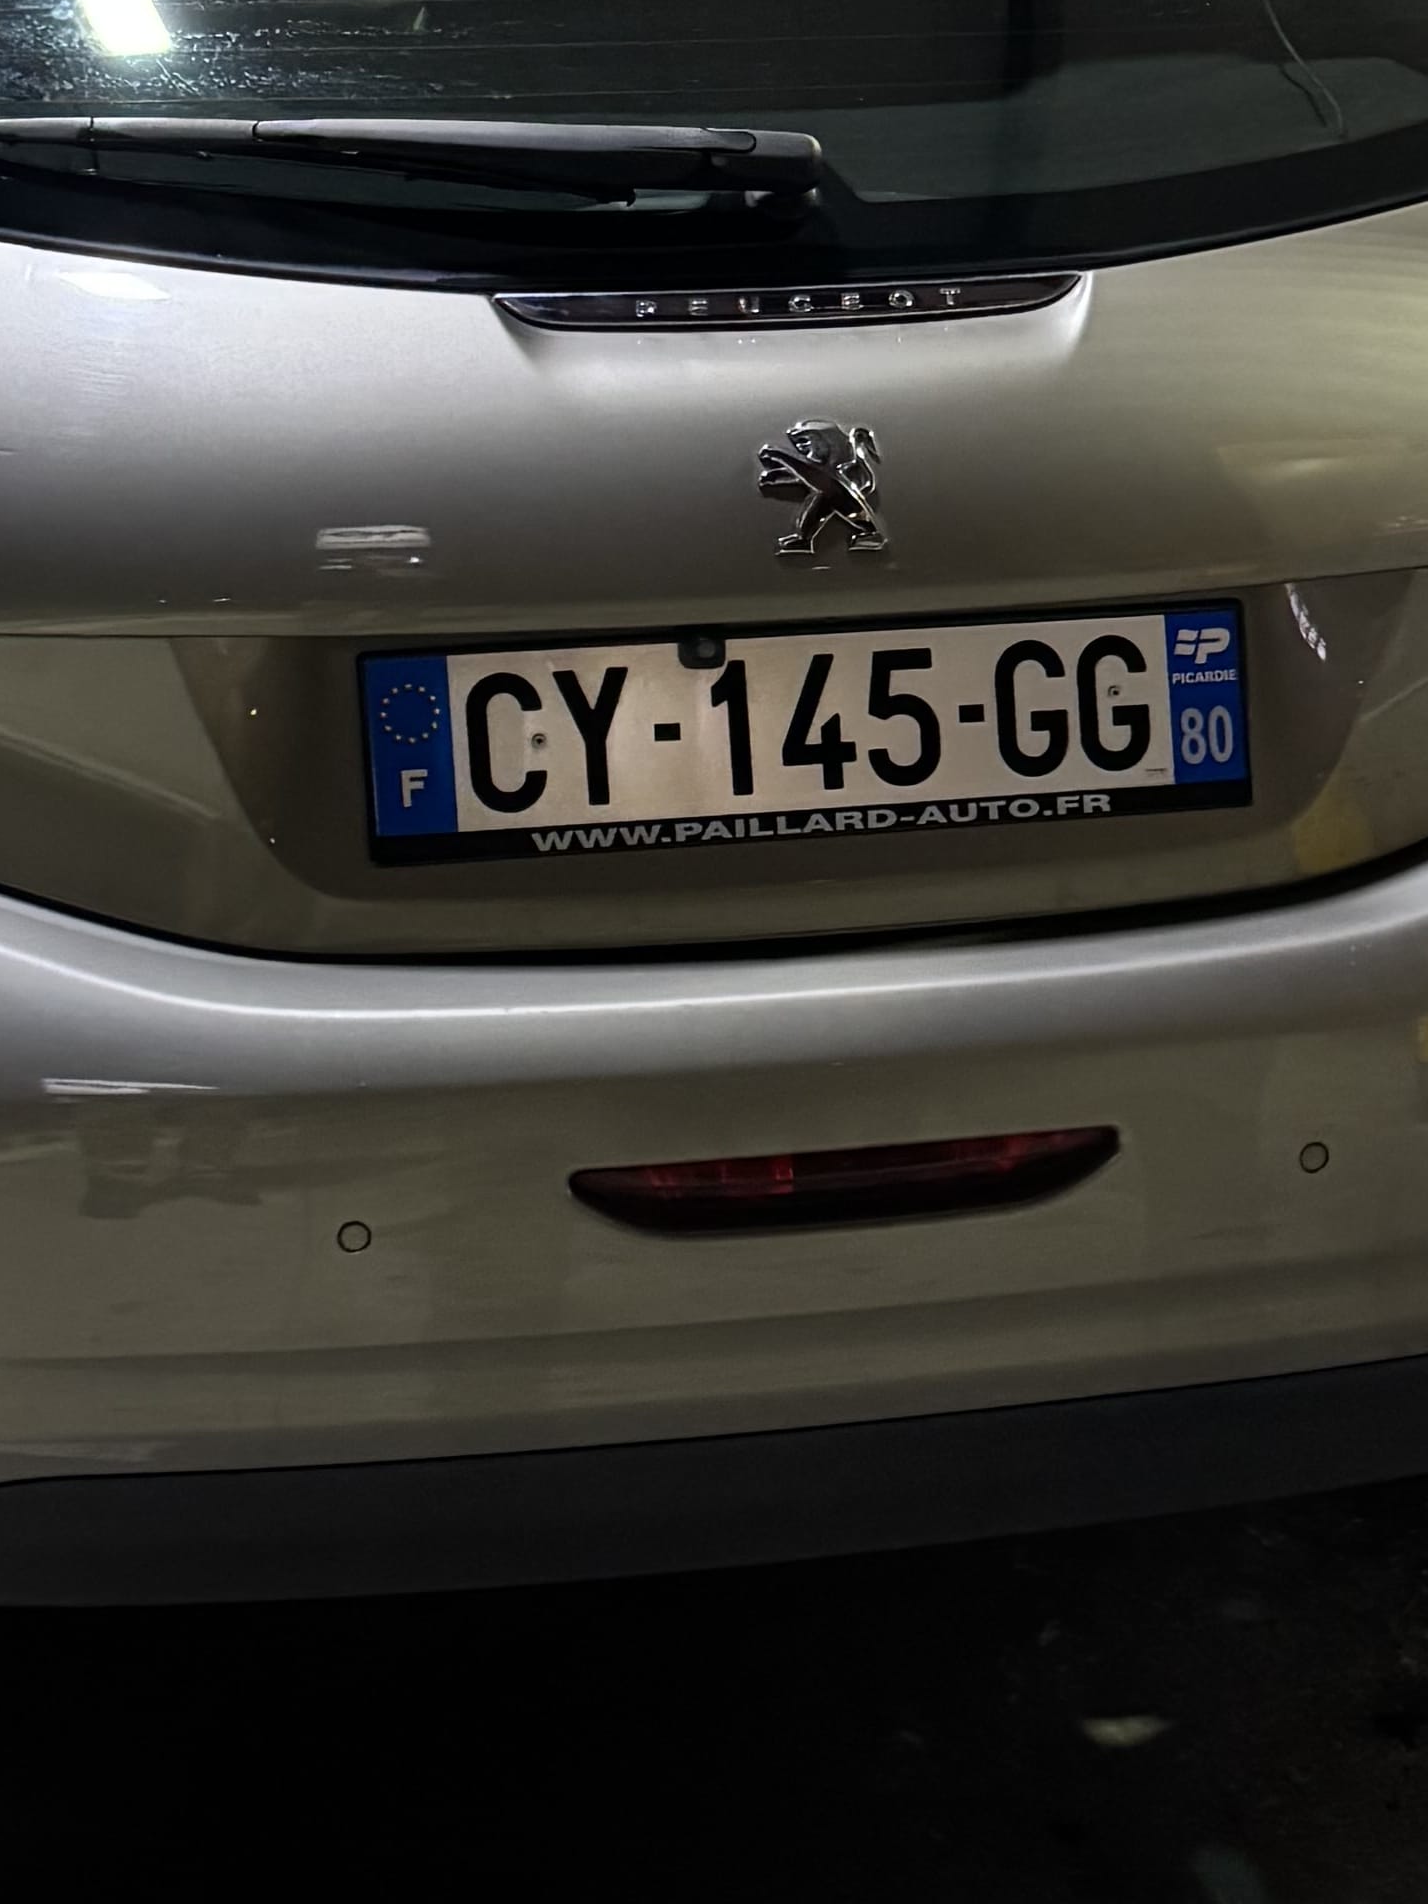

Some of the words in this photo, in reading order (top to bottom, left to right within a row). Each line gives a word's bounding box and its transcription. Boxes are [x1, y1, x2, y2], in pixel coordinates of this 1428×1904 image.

[635, 287, 961, 318] PEUGEOT
[1172, 669, 1238, 685] PICARDIE
[466, 634, 1151, 813] CY-145-GG
[1181, 705, 1234, 765] 80
[400, 769, 428, 808] F
[532, 794, 1111, 853] WWW.PAILLARD-AUTO.FR
